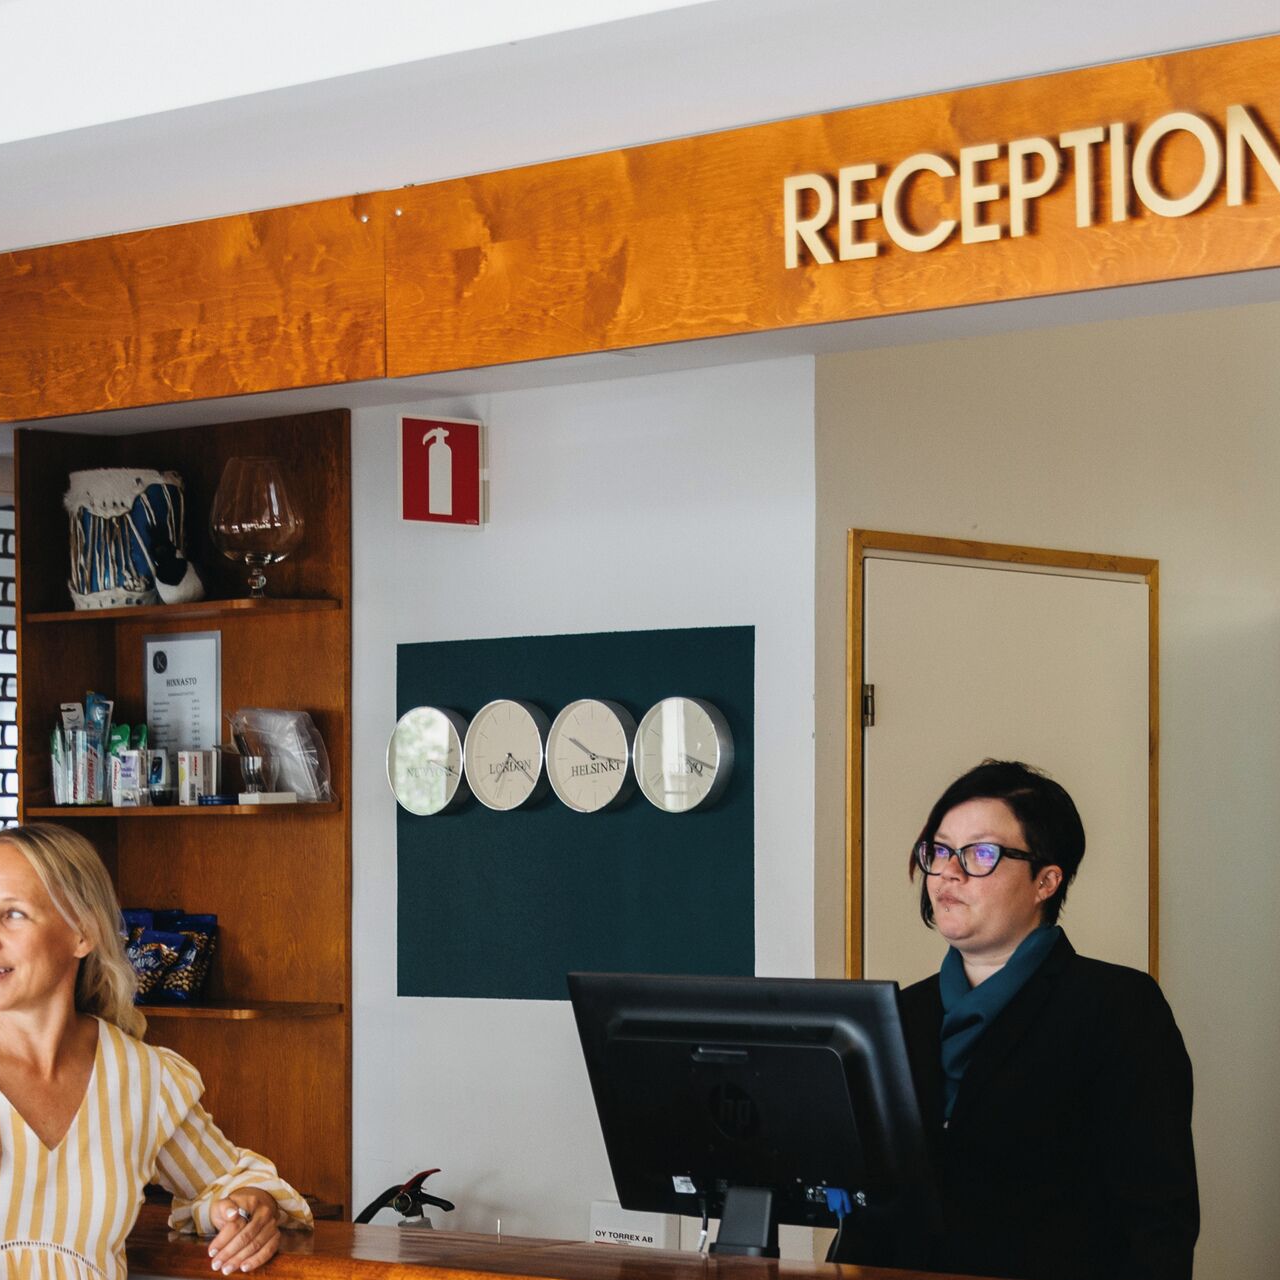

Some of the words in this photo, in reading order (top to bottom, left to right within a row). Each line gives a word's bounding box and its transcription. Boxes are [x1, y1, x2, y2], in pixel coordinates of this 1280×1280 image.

[166, 677, 197, 687] HINNASTO
[489, 759, 531, 775] LONDON
[571, 759, 621, 777] HELSINKI
[608, 1231, 640, 1242] TORREX
[641, 1235, 654, 1243] AB
